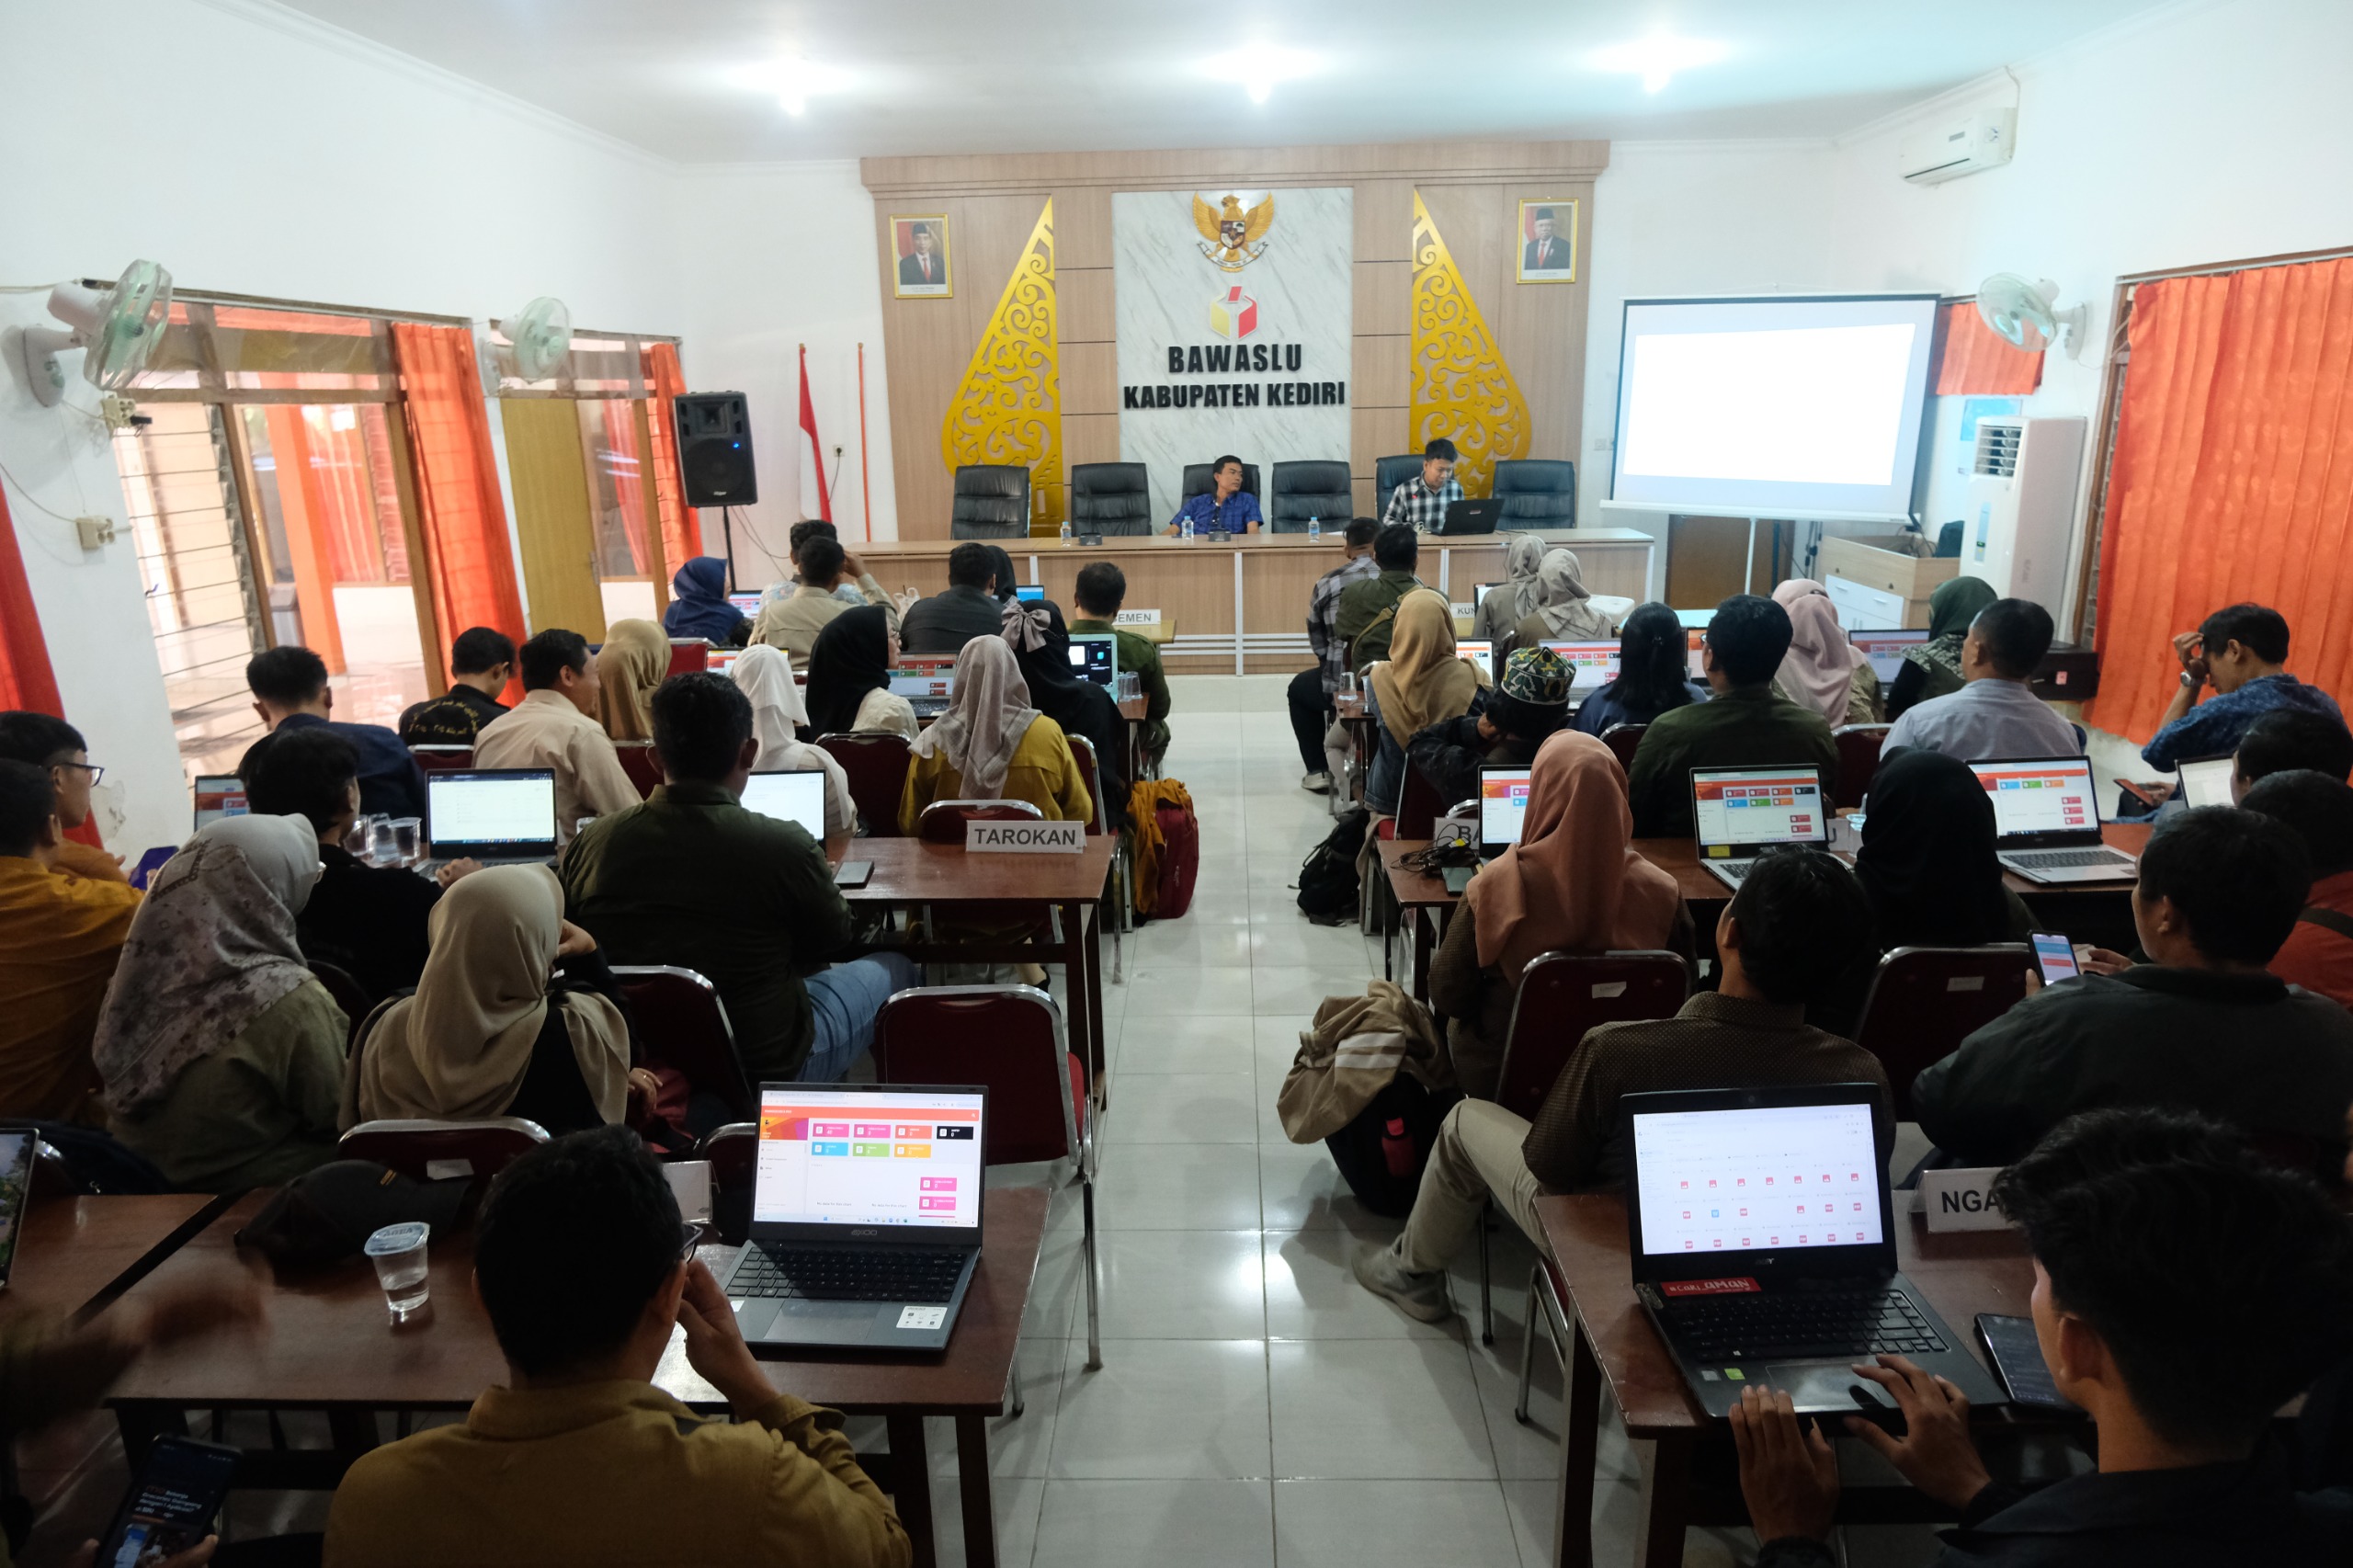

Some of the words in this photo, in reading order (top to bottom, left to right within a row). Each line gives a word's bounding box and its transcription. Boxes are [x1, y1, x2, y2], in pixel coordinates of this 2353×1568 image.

[1168, 344, 1302, 373] BAWASLU
[1124, 384, 1259, 408] KABUPATEN
[1267, 381, 1345, 406] KEDIRI
[1114, 613, 1152, 622] EMEN
[974, 828, 1076, 846] TAROKAN
